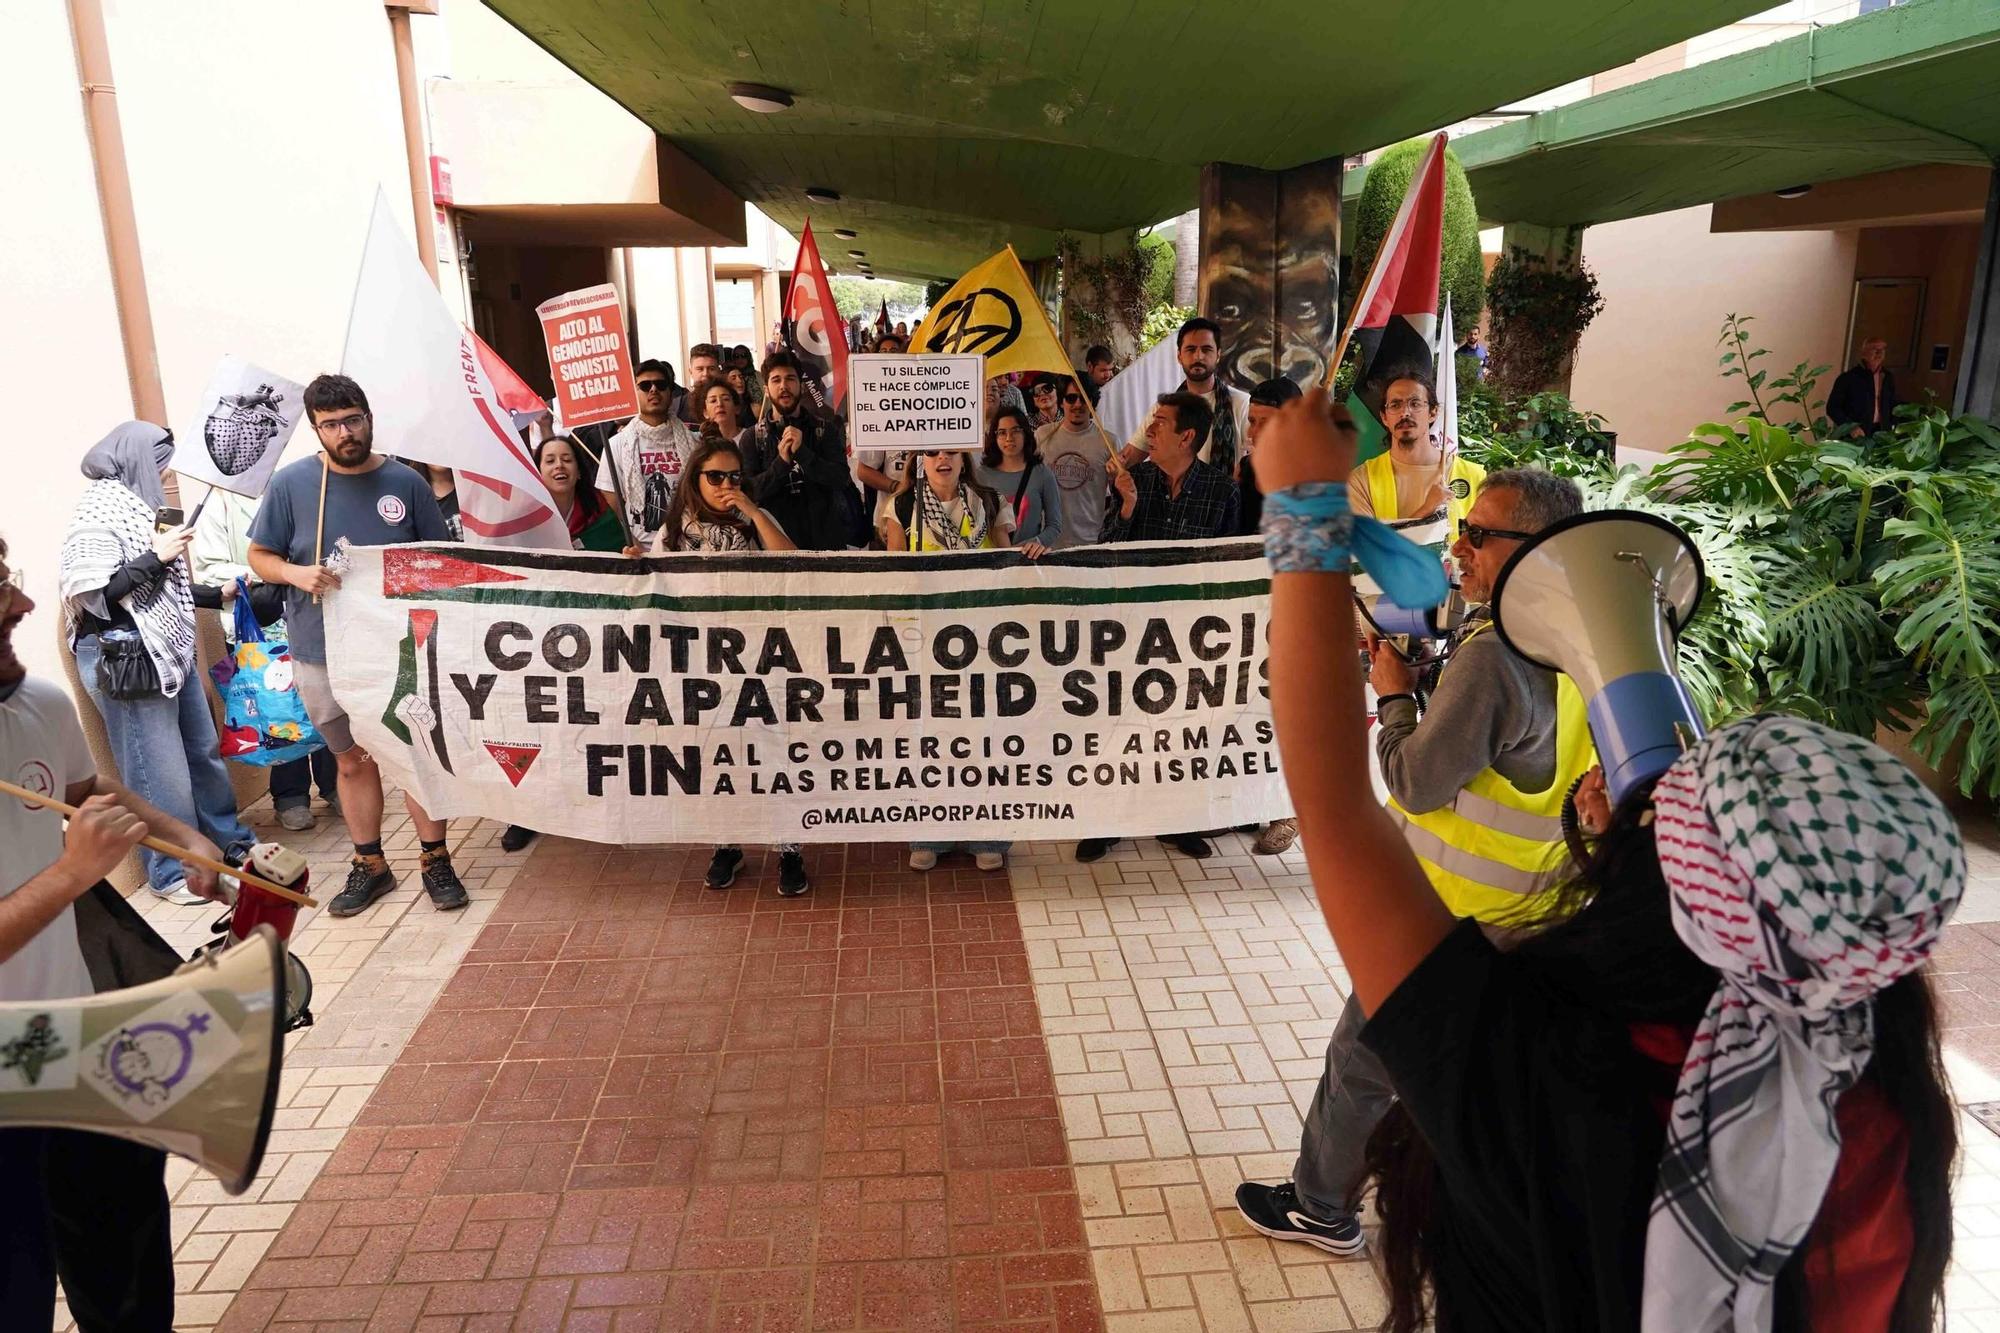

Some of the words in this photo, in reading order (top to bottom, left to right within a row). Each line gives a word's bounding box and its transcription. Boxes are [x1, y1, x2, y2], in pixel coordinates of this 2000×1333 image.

[559, 318, 587, 341] ALTO
[588, 315, 605, 334] AL
[551, 332, 620, 363] GENOCIDIO
[460, 335, 482, 395] FRENT
[559, 354, 619, 382] SIONISTA
[882, 367, 896, 377] TU
[899, 366, 951, 377] SILENCIO
[568, 381, 587, 401] DE
[585, 375, 621, 397] GAZA
[805, 379, 824, 409] Melilla
[862, 383, 876, 392] TE
[879, 382, 911, 392] HACE
[913, 380, 970, 391] CÓMPLICE
[857, 403, 876, 412] DEL
[879, 397, 967, 412] GENOCIDIO
[970, 401, 977, 409] Y
[862, 424, 881, 433] DEL
[884, 417, 972, 432] APARTHEID
[484, 621, 803, 676] CONTRA
[826, 625, 910, 675] LA
[932, 612, 1272, 671] OCUPACI
[449, 673, 498, 721] Y
[523, 675, 600, 725] EL
[624, 671, 1037, 727] APARTHEID
[585, 743, 702, 797] FIN
[712, 743, 762, 767] AL
[787, 734, 1025, 764] COMERCIO
[1052, 732, 1099, 757] DE
[1122, 720, 1274, 755] ARMAS
[712, 772, 736, 796] A
[750, 769, 815, 796] LAS
[830, 763, 1053, 793] RELACIONES
[1067, 760, 1140, 787] CON
[1154, 751, 1278, 784] ISRAEL
[801, 802, 1075, 830] @MALAGAPORPALESTINA
